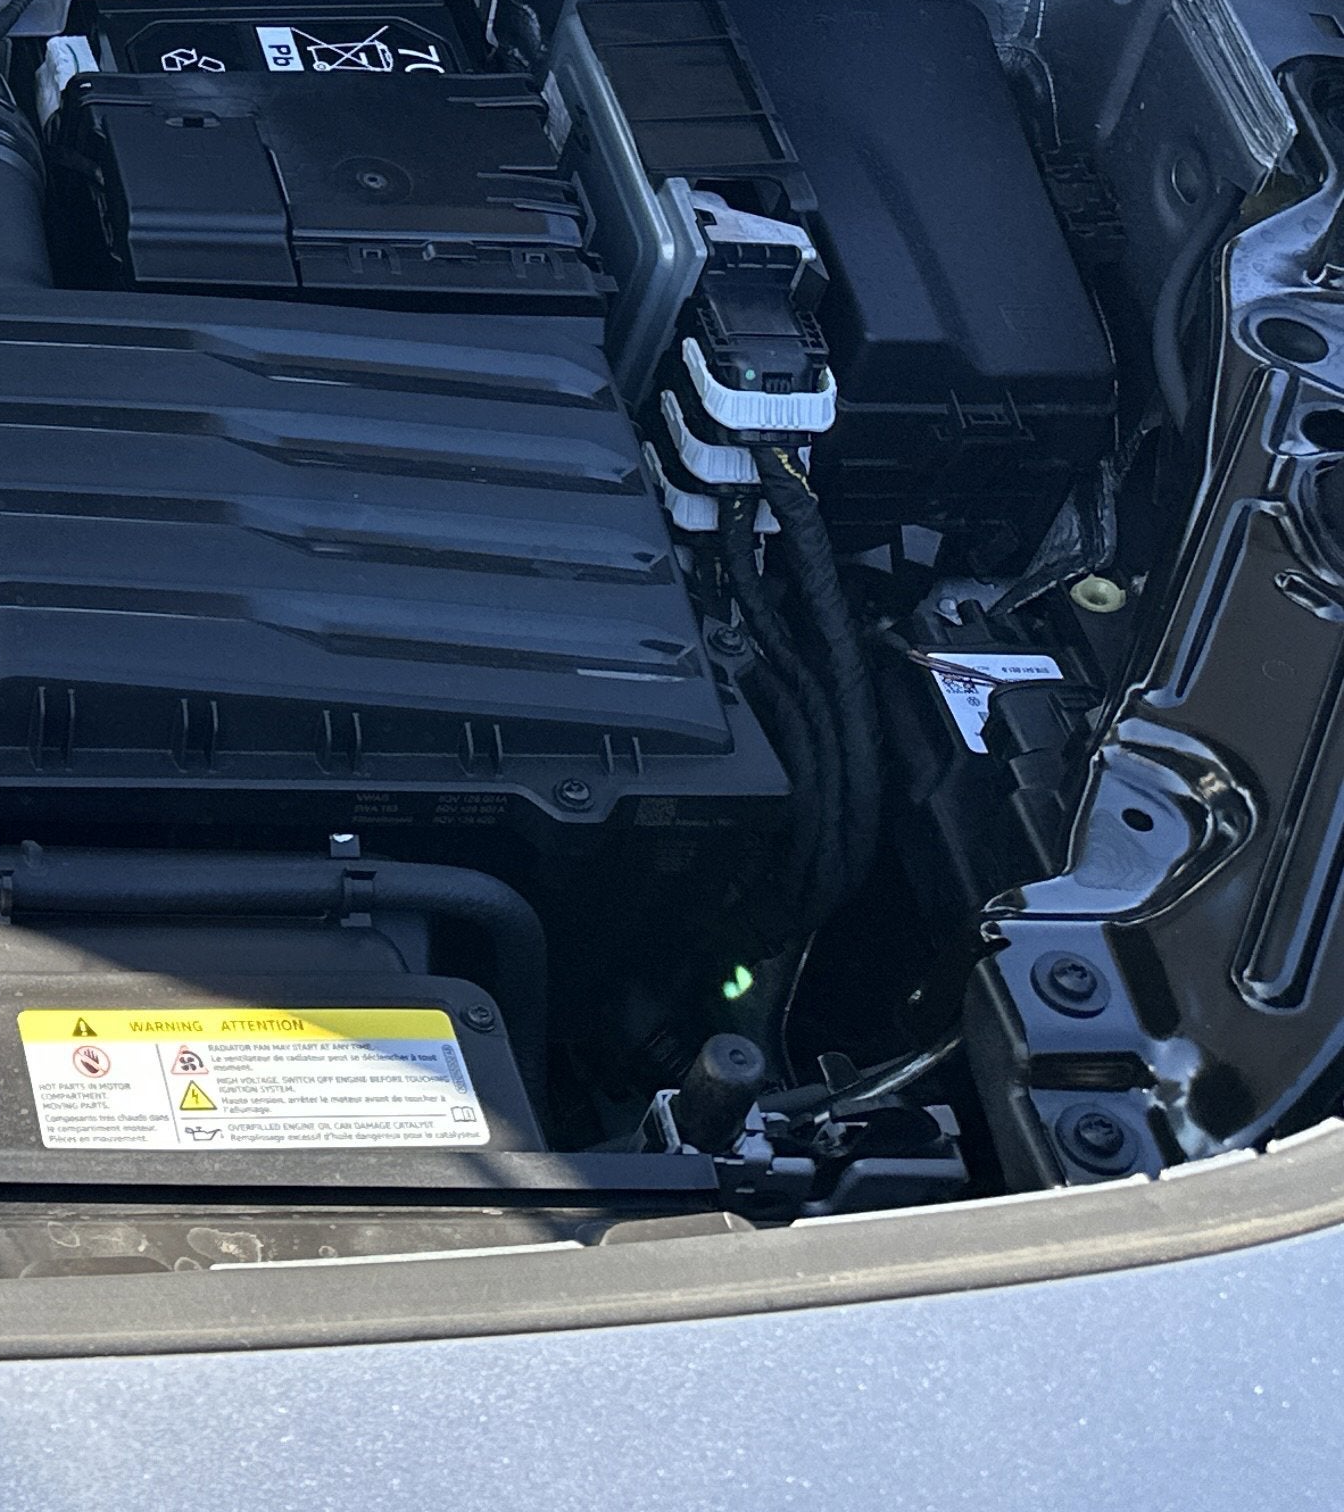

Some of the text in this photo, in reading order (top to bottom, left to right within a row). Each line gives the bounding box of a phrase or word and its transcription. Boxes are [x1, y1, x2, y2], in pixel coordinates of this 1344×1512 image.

[268, 43, 291, 67] Pb
[129, 1019, 305, 1033] WARNING ATTENTION
[327, 1054, 348, 1063] peut
[282, 1076, 315, 1084] SWITCH
[369, 1075, 404, 1083] BEFORE
[405, 1075, 450, 1083] TOUCHING
[39, 1082, 56, 1090] HOT
[59, 1082, 85, 1090] PARTS
[99, 1082, 131, 1090] MOTOR
[222, 1096, 248, 1104] Haute
[405, 1095, 438, 1103] toucher
[43, 1102, 78, 1110] MOVING
[45, 1114, 98, 1123] Composants
[57, 1125, 120, 1133] compartiment
[228, 1123, 281, 1131] OVERFILLED
[355, 1121, 391, 1129] DAMAGE
[231, 1134, 285, 1143] Remplissage
[355, 1133, 400, 1141] dangereux
